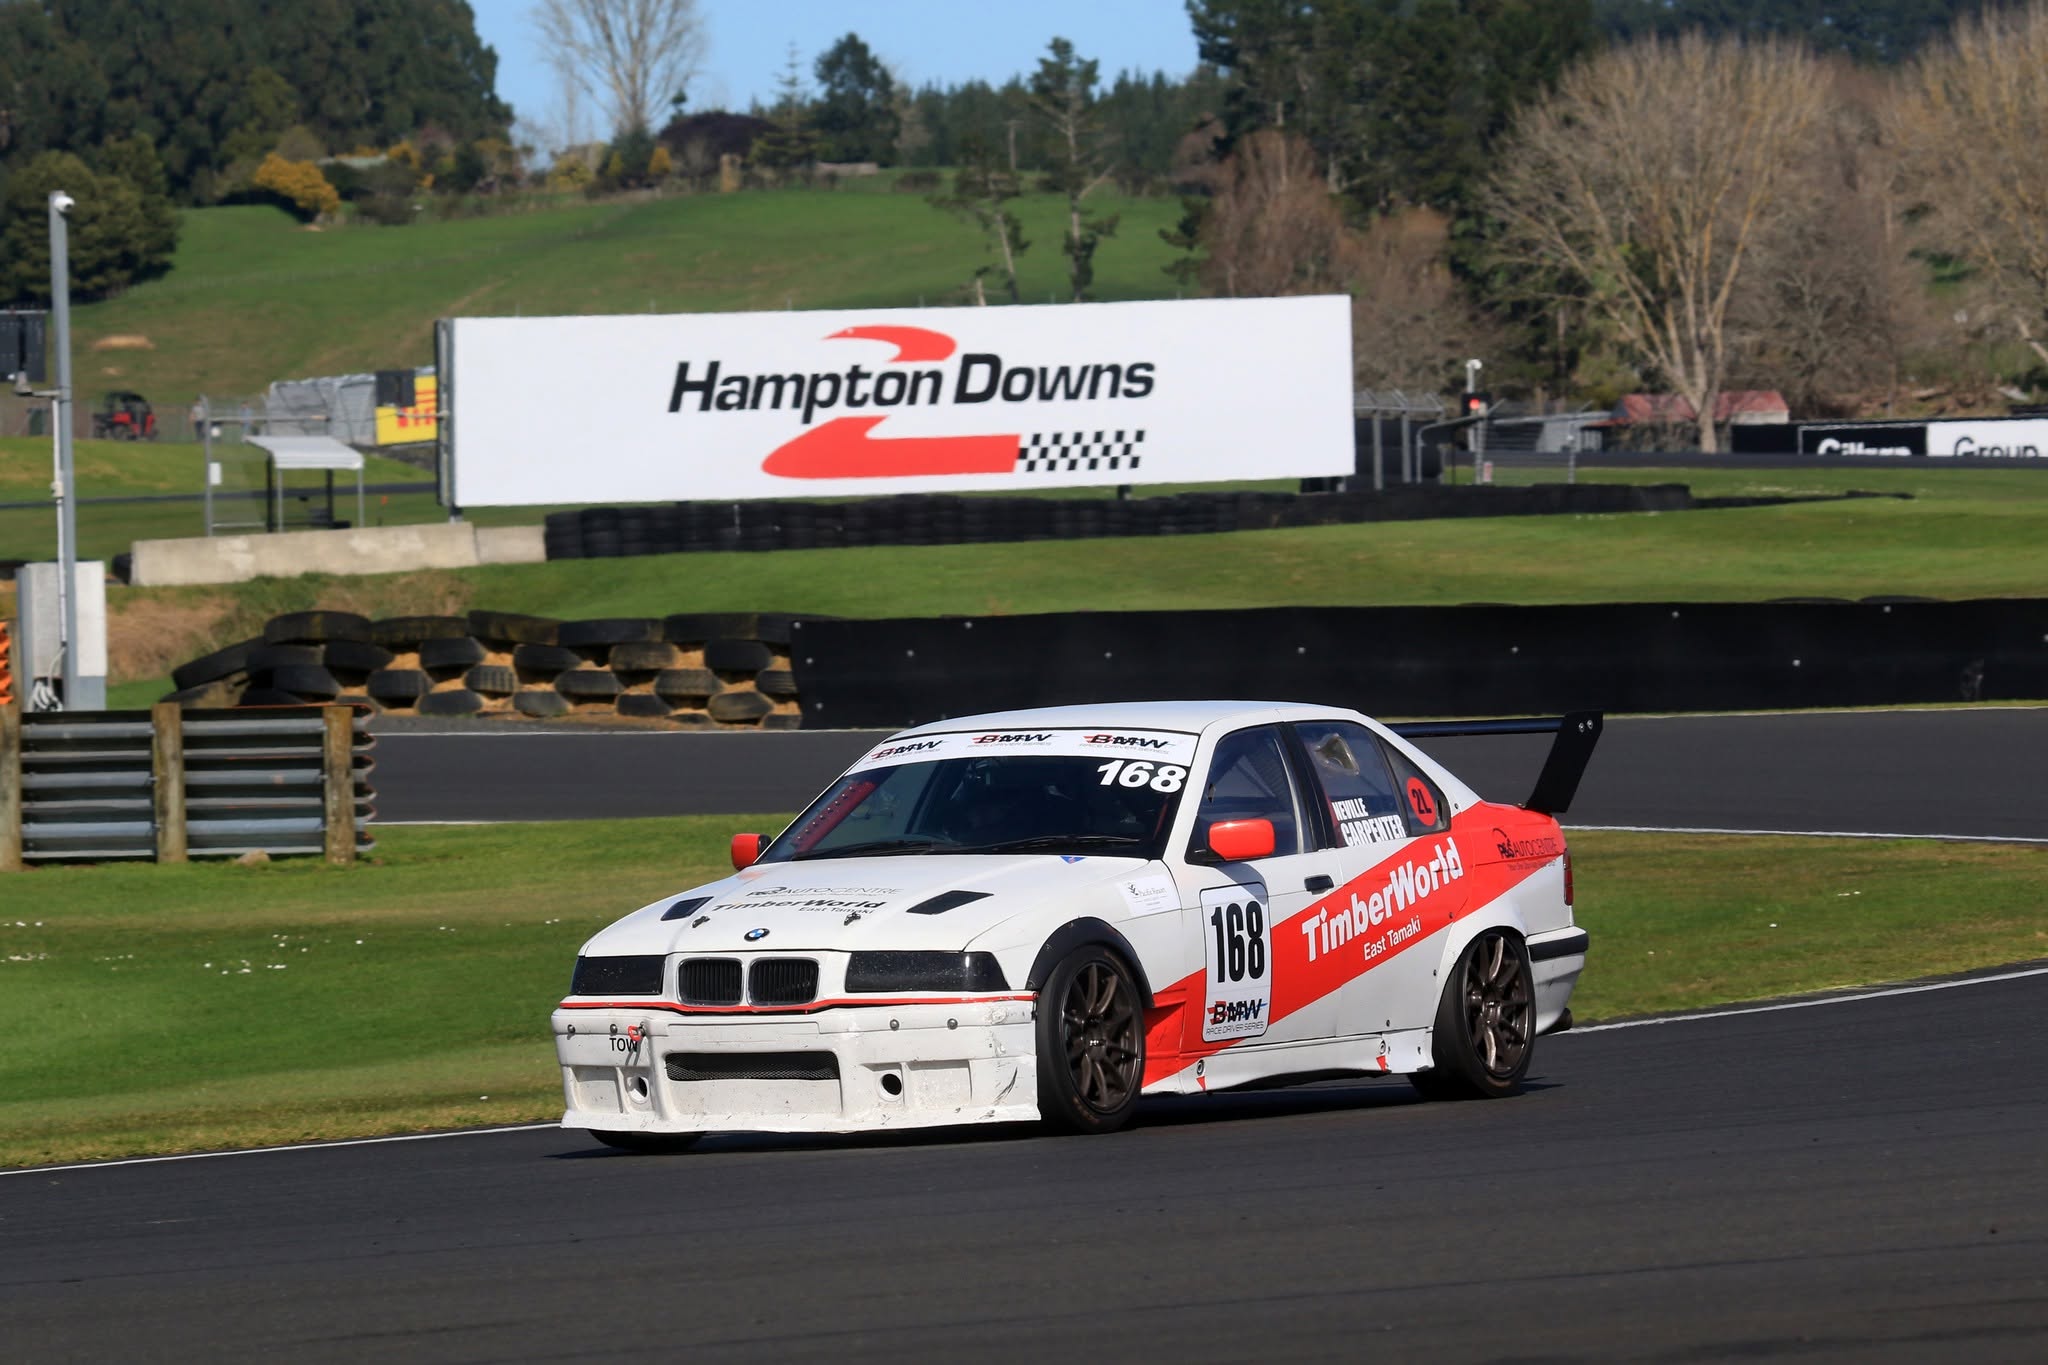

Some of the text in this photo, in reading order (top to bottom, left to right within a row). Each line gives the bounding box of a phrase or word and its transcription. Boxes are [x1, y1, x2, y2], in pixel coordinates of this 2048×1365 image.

[668, 352, 1156, 425] Hampton Downs
[1083, 734, 1168, 748] BMW
[1097, 760, 1187, 793] 168
[1331, 798, 1369, 821] NEVILLE
[1411, 788, 1432, 815] 2L
[1340, 814, 1407, 848] CARPENTER
[712, 899, 887, 912] TimberWorld
[829, 906, 875, 914] Tamaki
[1302, 836, 1463, 962] TimberWorld
[1211, 900, 1264, 983] 168
[1363, 915, 1422, 960] East Tamaki
[1207, 998, 1263, 1025] BMW
[1244, 1021, 1264, 1030] SERIES
[609, 1037, 639, 1052] TOW
